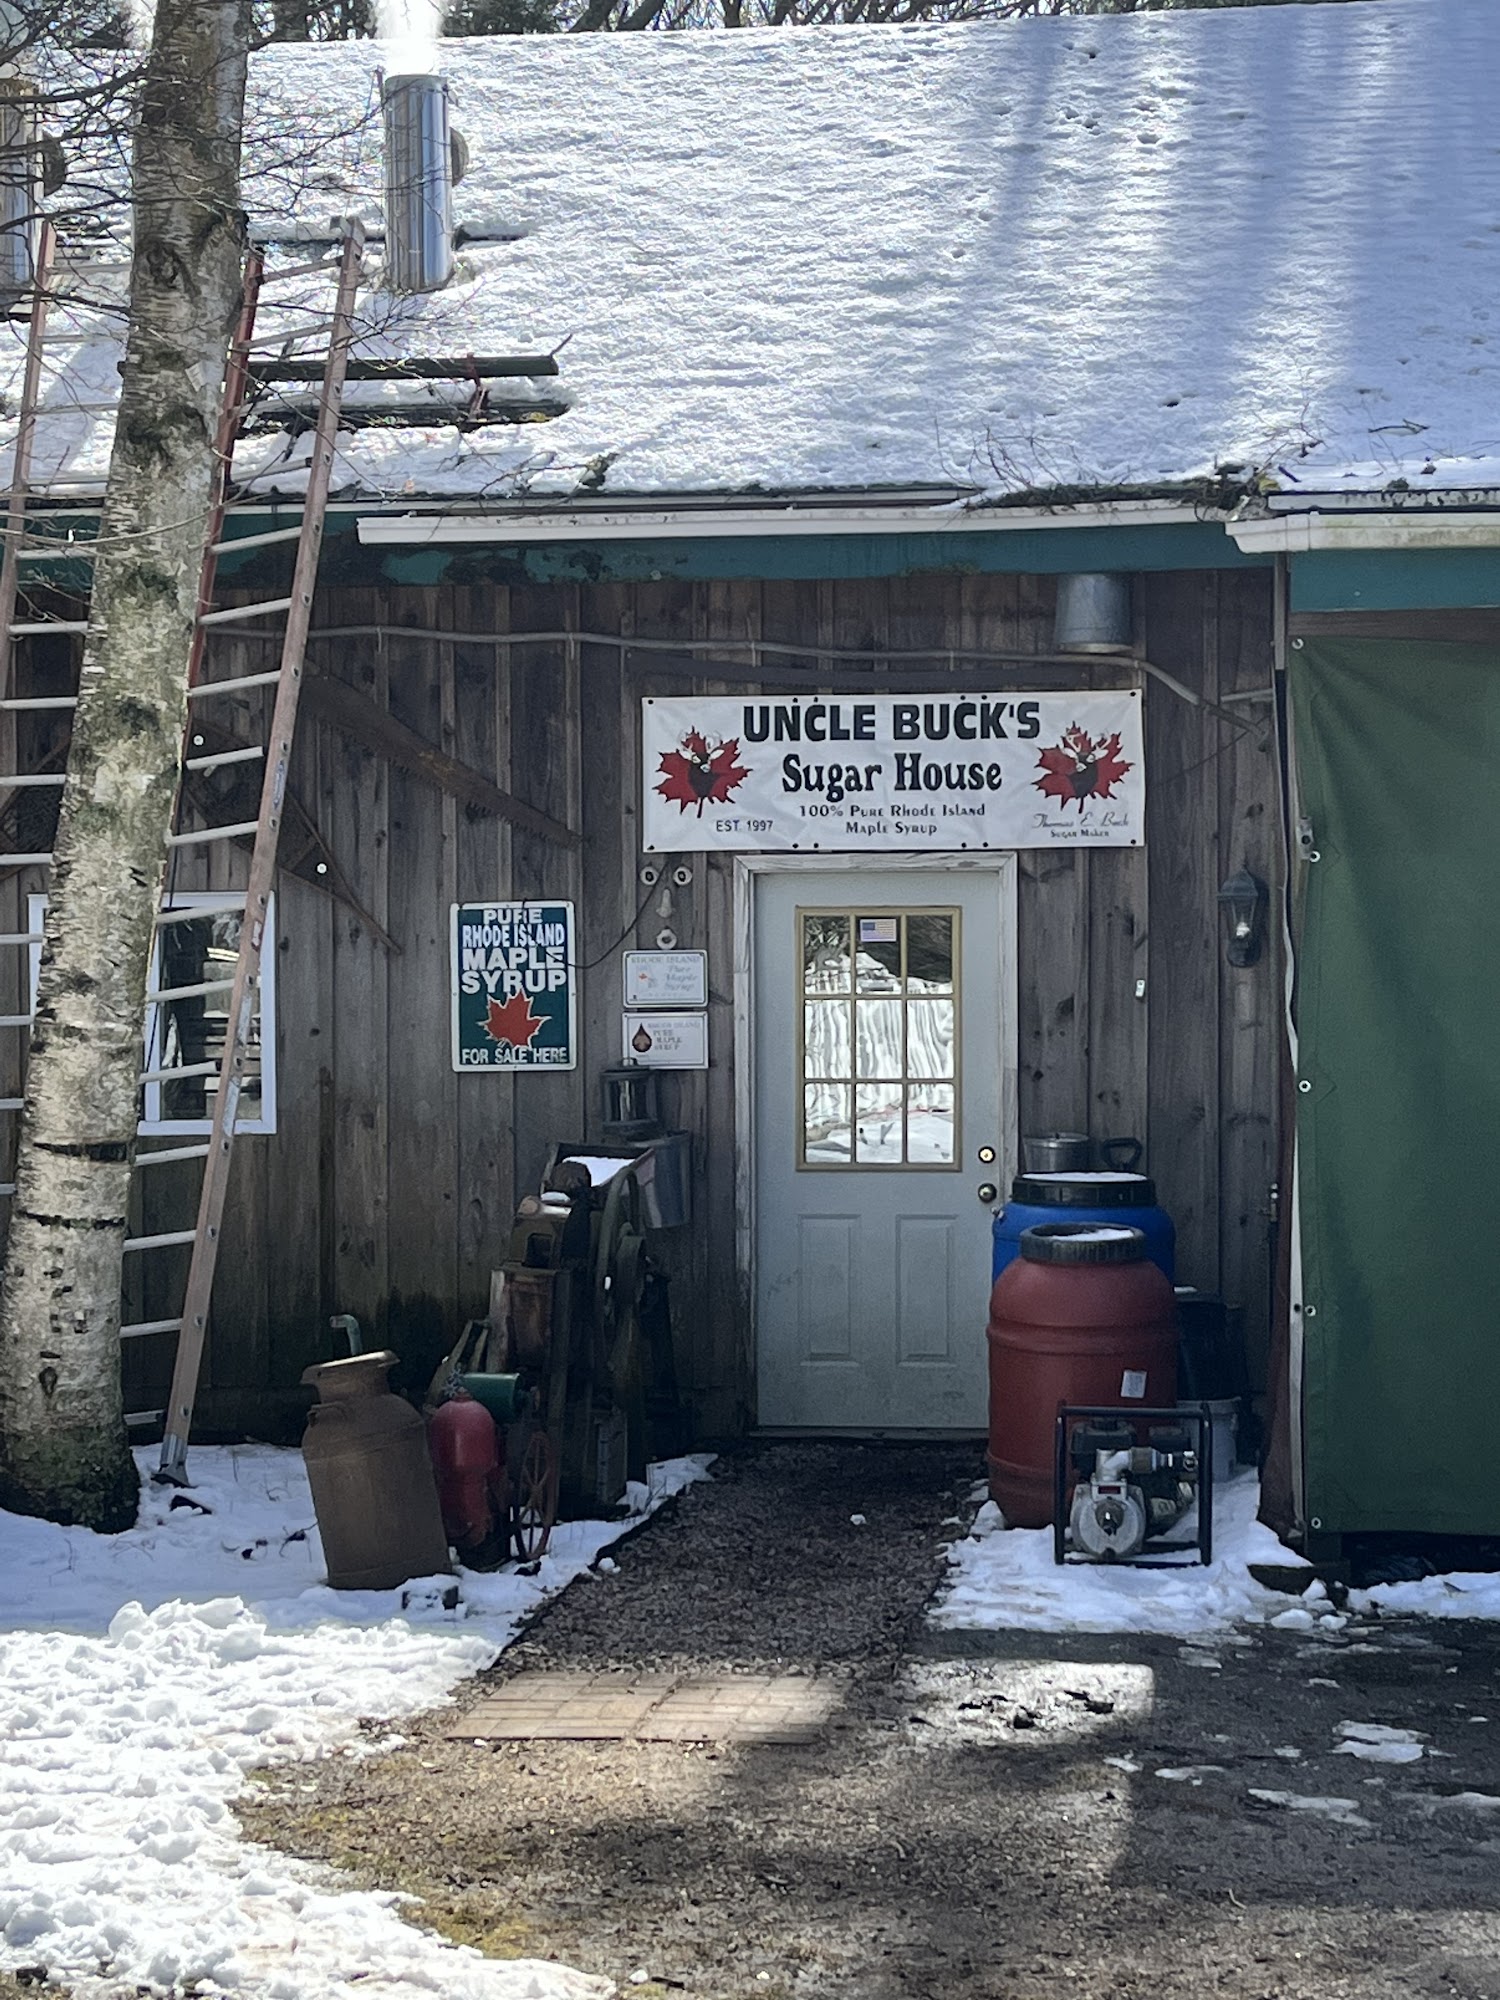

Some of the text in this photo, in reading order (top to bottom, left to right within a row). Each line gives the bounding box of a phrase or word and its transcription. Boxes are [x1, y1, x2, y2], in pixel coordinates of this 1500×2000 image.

[743, 701, 1041, 742] UNCLE BUCK'S
[782, 752, 1002, 802] Sugar House
[800, 805, 844, 817] 100%
[746, 819, 774, 832] 1997
[483, 908, 543, 924] PURE
[462, 923, 565, 948] RHODE ISLAND
[462, 946, 565, 971] MAPLE
[461, 969, 567, 994] SYRUP
[462, 1047, 567, 1064] FOR SALE HERE
